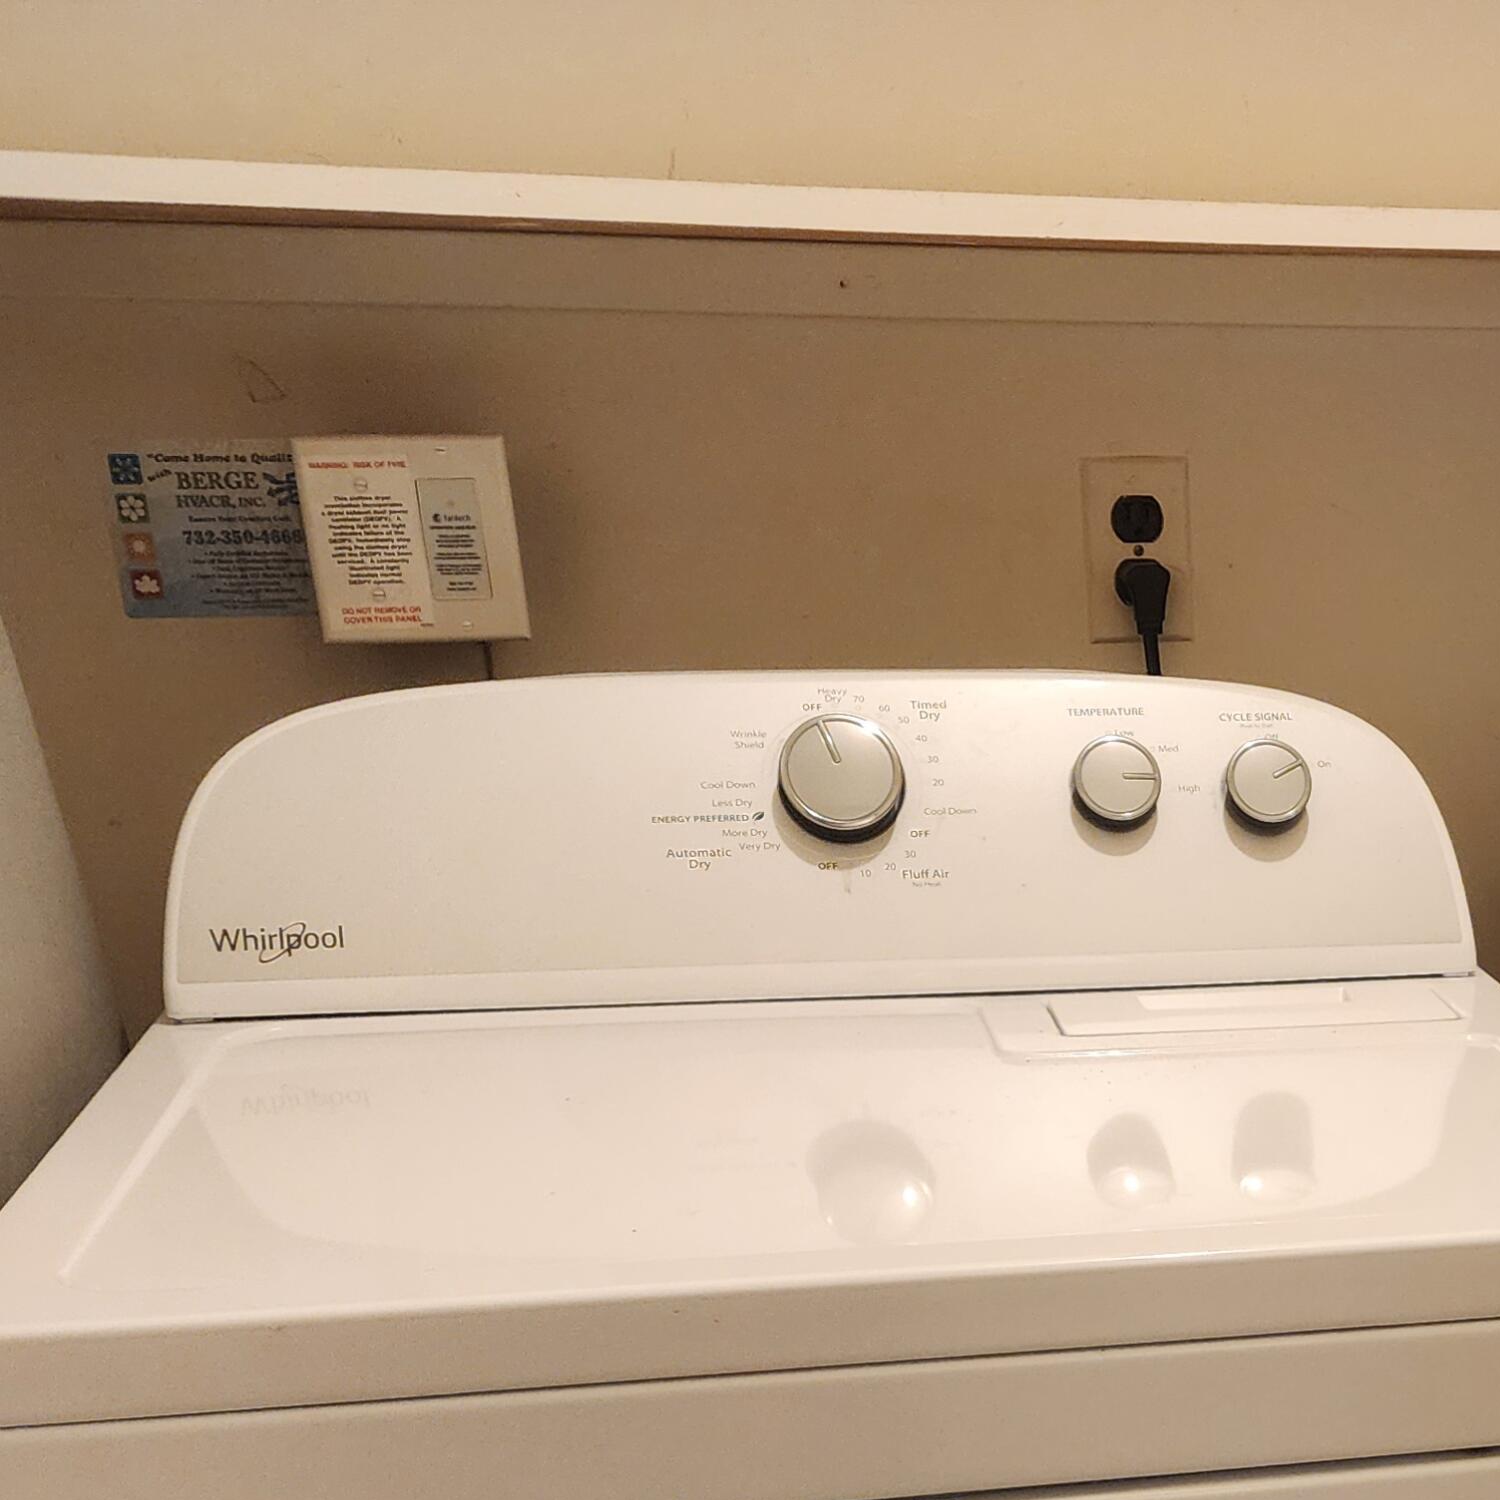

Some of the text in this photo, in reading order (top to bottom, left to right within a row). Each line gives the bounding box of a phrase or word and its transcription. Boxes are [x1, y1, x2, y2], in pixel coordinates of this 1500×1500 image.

[193, 454, 230, 463] Home
[234, 454, 247, 463] to
[174, 471, 260, 490] BERGE
[342, 607, 355, 615] DO
[817, 687, 848, 697] Heavy
[824, 694, 843, 704] Dry
[853, 695, 865, 703] 70
[802, 703, 822, 711] OFF
[909, 700, 948, 711] Timed
[918, 710, 941, 722] Dry
[1067, 707, 1144, 717] TEMPERATURE
[1218, 711, 1294, 722] CYCLE SIGNAL
[897, 716, 910, 725] 50
[729, 728, 768, 739] Wrinkle
[914, 735, 928, 743] 40
[734, 740, 765, 750] Shield
[1158, 744, 1180, 753] Med
[927, 756, 939, 764] 30
[1317, 760, 1332, 768] On
[700, 780, 756, 790] Cool Down
[932, 778, 945, 787] 20
[1178, 785, 1201, 795] High
[711, 798, 753, 808] Less Dry
[923, 807, 947, 817] Cool
[651, 814, 750, 824] ENERGY PREFERRED
[722, 828, 768, 838] More Dry
[739, 841, 781, 851] Very Dry
[666, 847, 733, 858] Automatic
[904, 850, 917, 859] 30
[689, 859, 712, 871] Dry
[884, 863, 897, 872] 20
[860, 869, 872, 878] 10
[902, 869, 950, 880] Fluff Air
[208, 922, 345, 963] Whirlpool
